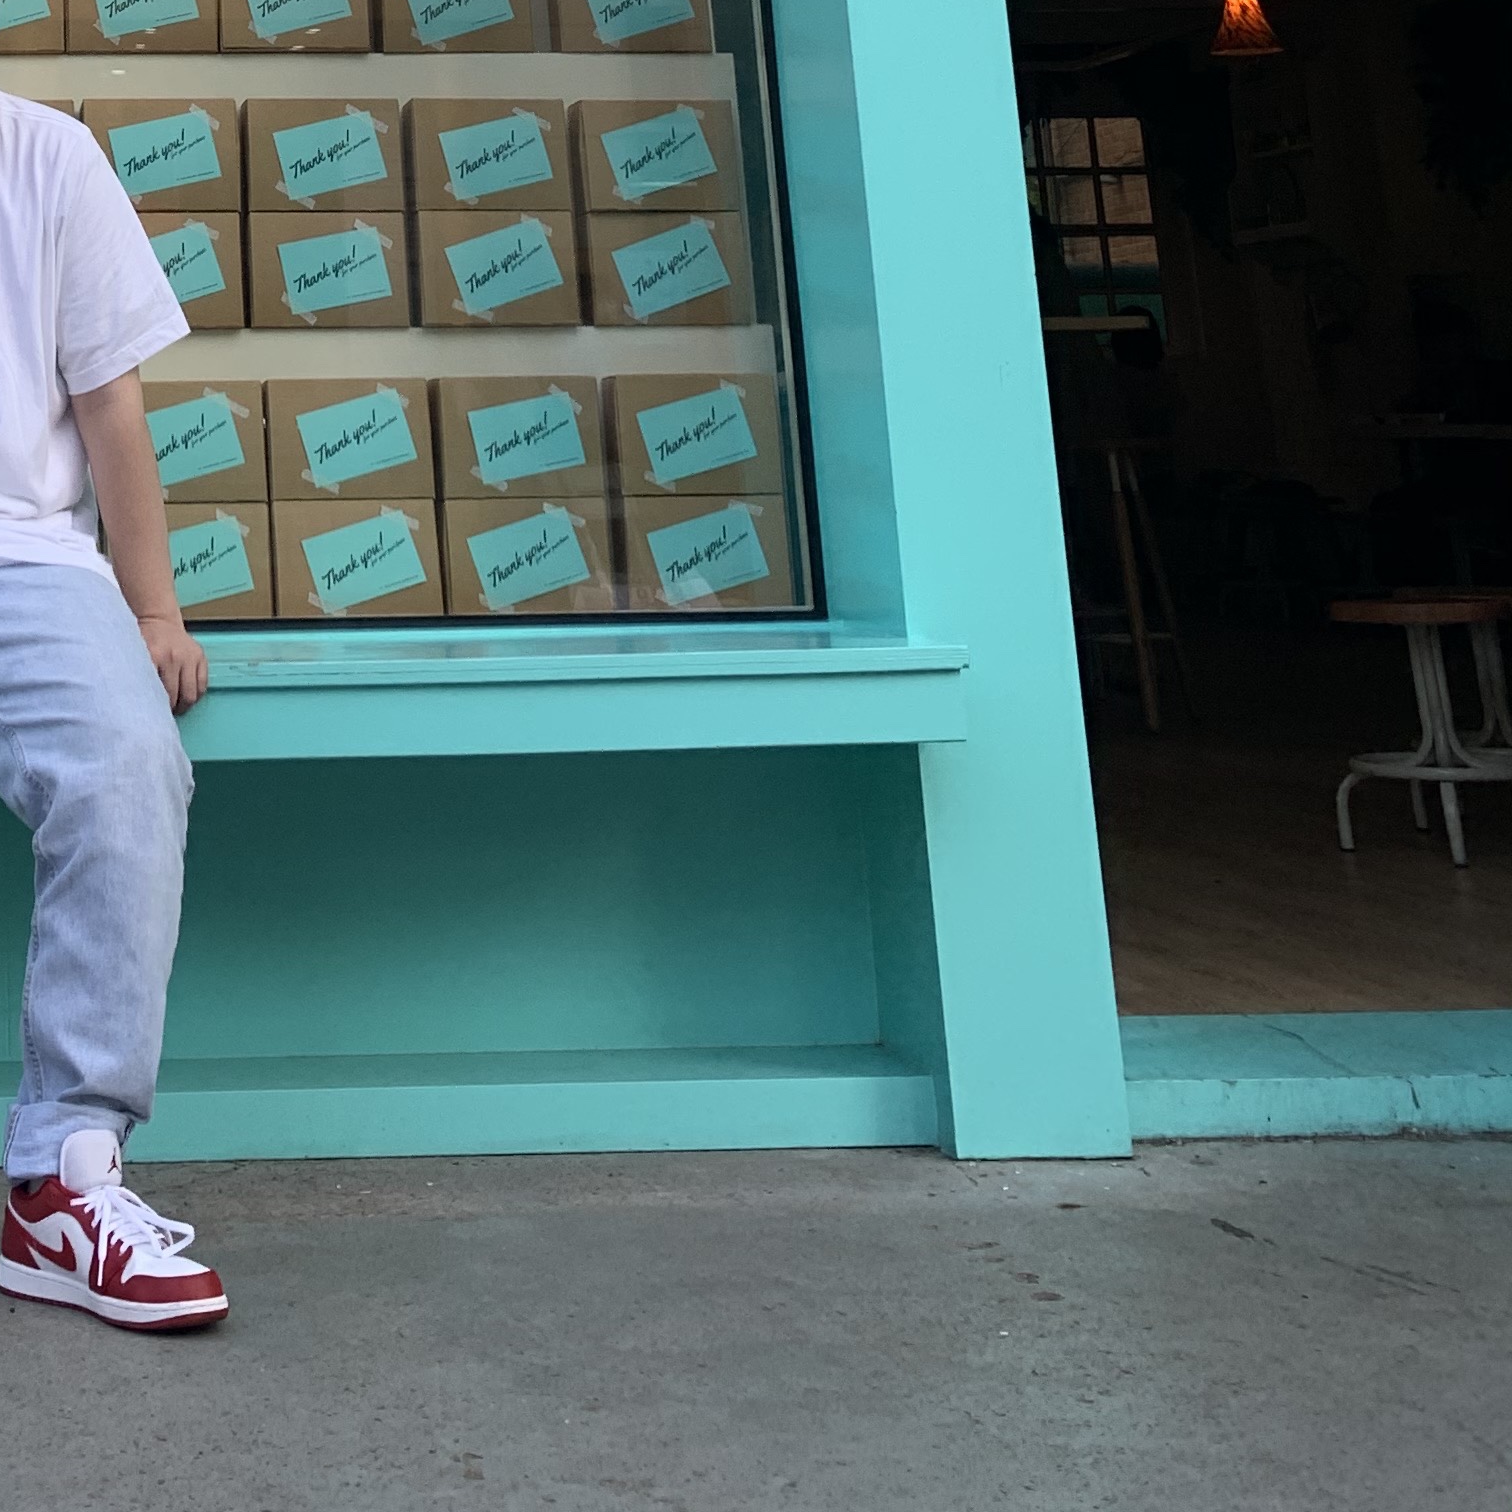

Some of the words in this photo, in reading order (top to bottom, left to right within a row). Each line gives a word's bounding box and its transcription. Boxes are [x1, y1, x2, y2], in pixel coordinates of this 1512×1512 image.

[124, 146, 161, 177] Thank
[162, 129, 184, 161] you!
[290, 148, 326, 179] Thank
[328, 130, 349, 162] you!
[456, 149, 492, 179] Thank
[493, 131, 515, 163] you!
[620, 147, 655, 179] Thank
[655, 127, 676, 160] you!
[163, 242, 185, 277] you!
[294, 263, 331, 293] Thank
[333, 245, 356, 278] you!
[465, 260, 501, 294] Thank
[501, 239, 522, 274] you!
[633, 262, 667, 297] Thank
[668, 241, 689, 275] you!
[182, 414, 205, 450] you!
[315, 430, 352, 465] Thank
[354, 409, 376, 445] you!
[485, 430, 523, 463] Thank
[524, 412, 547, 446] you!
[655, 427, 693, 462] Thank
[694, 406, 716, 442] you!
[191, 537, 214, 573] you!
[322, 554, 360, 590] Thank
[361, 532, 384, 569] you!
[487, 552, 525, 586] Thank
[525, 530, 548, 566] you!
[666, 548, 704, 583] Thank
[705, 526, 727, 562] you!
